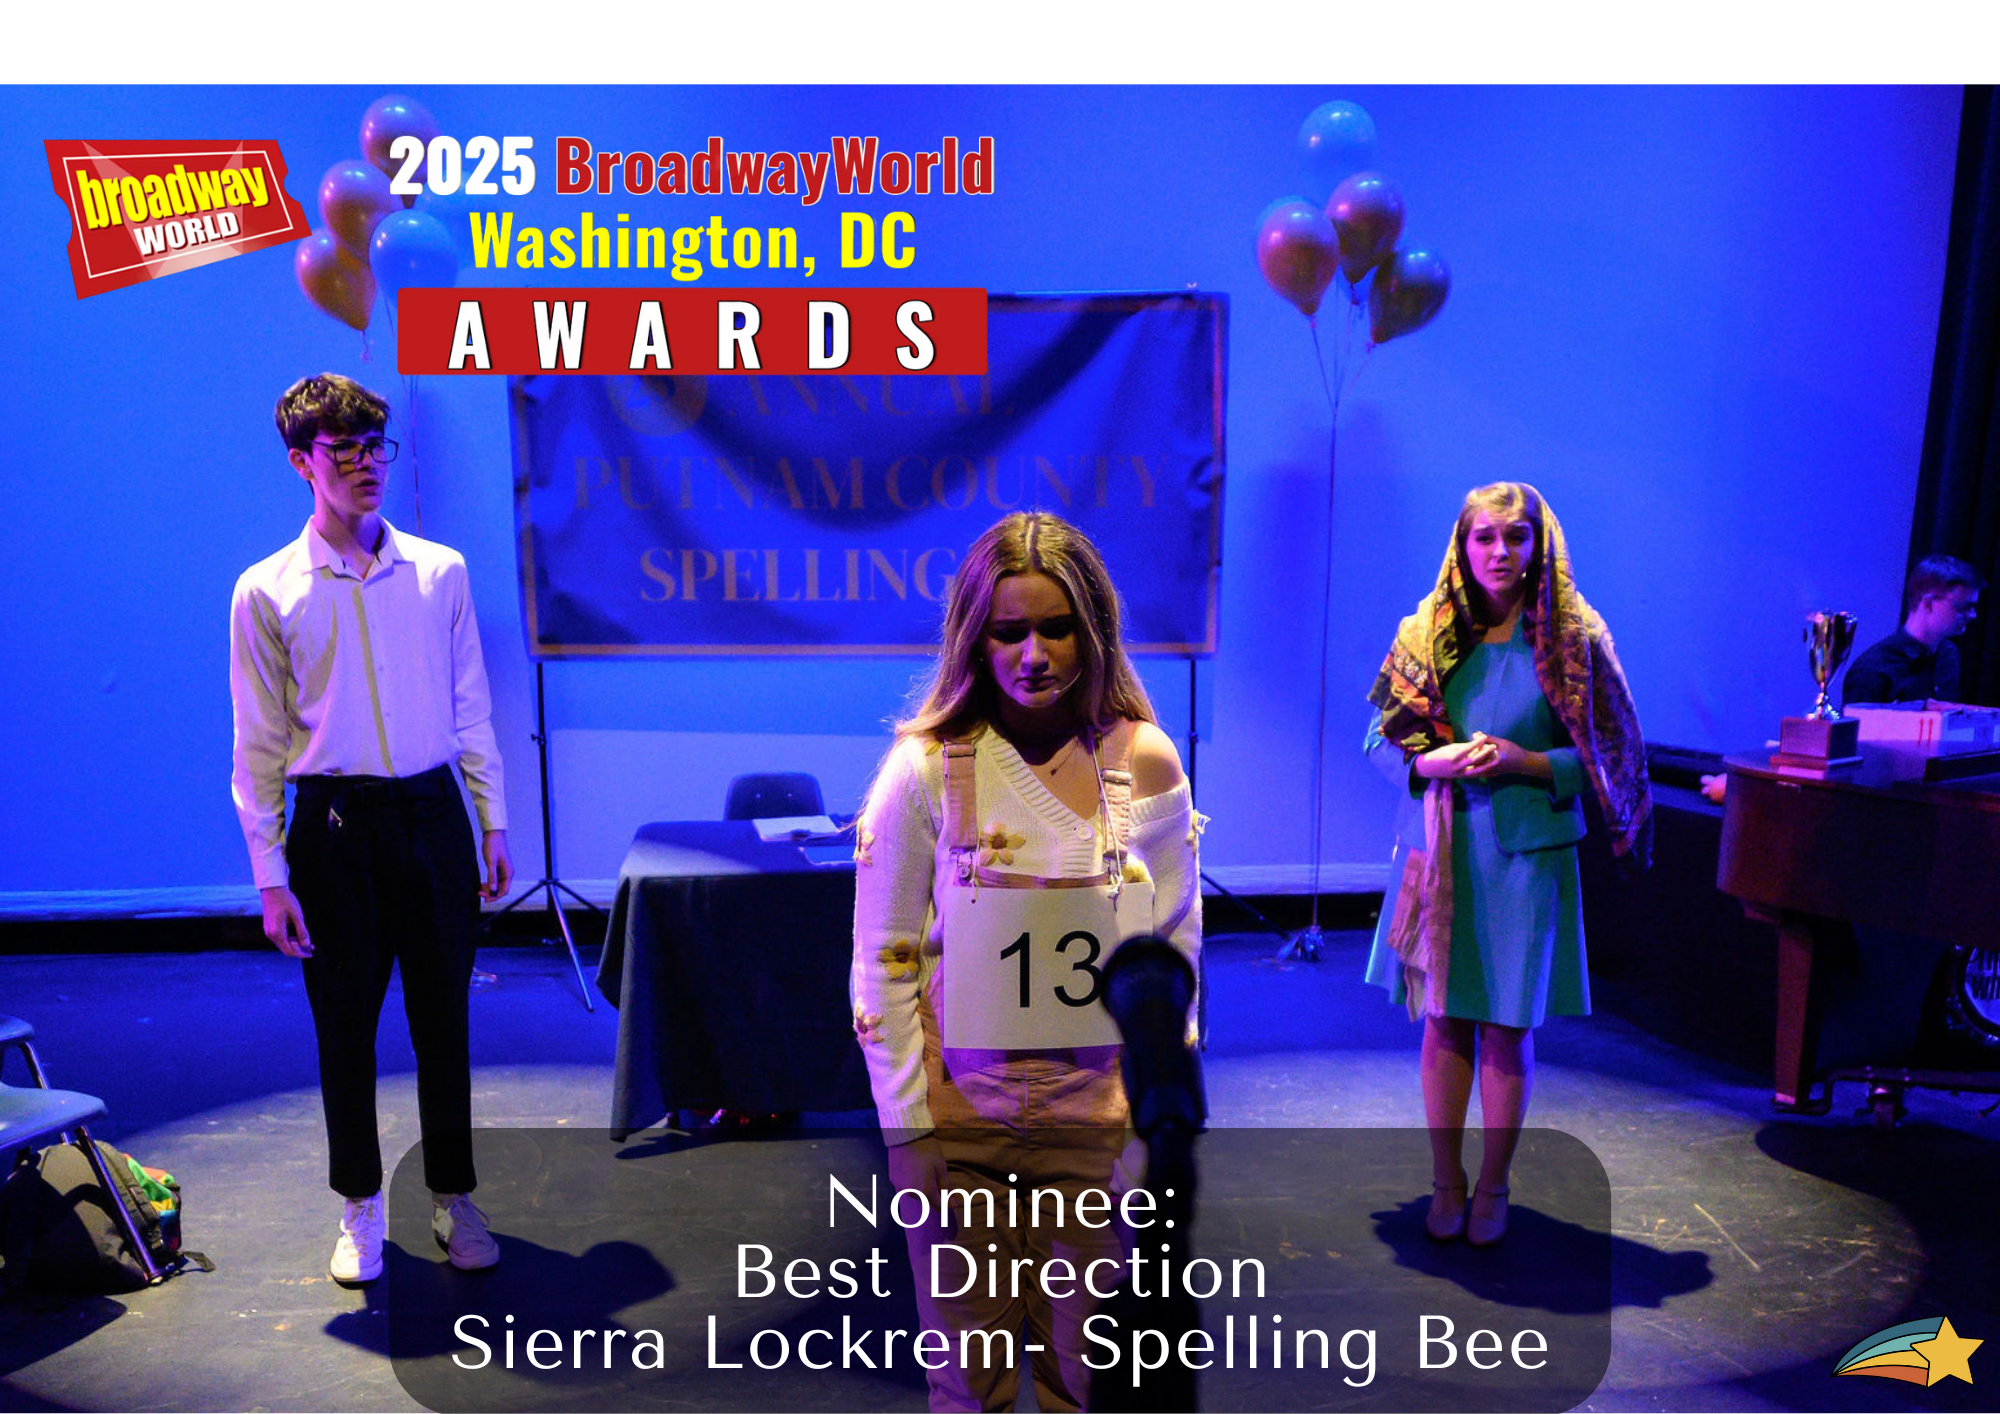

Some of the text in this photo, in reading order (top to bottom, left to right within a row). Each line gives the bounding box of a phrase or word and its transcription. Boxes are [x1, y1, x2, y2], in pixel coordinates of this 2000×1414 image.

[573, 455, 1168, 511] PUTNAM COUNTY
[639, 547, 956, 603] SPELLING
[1000, 930, 1104, 1008] 13
